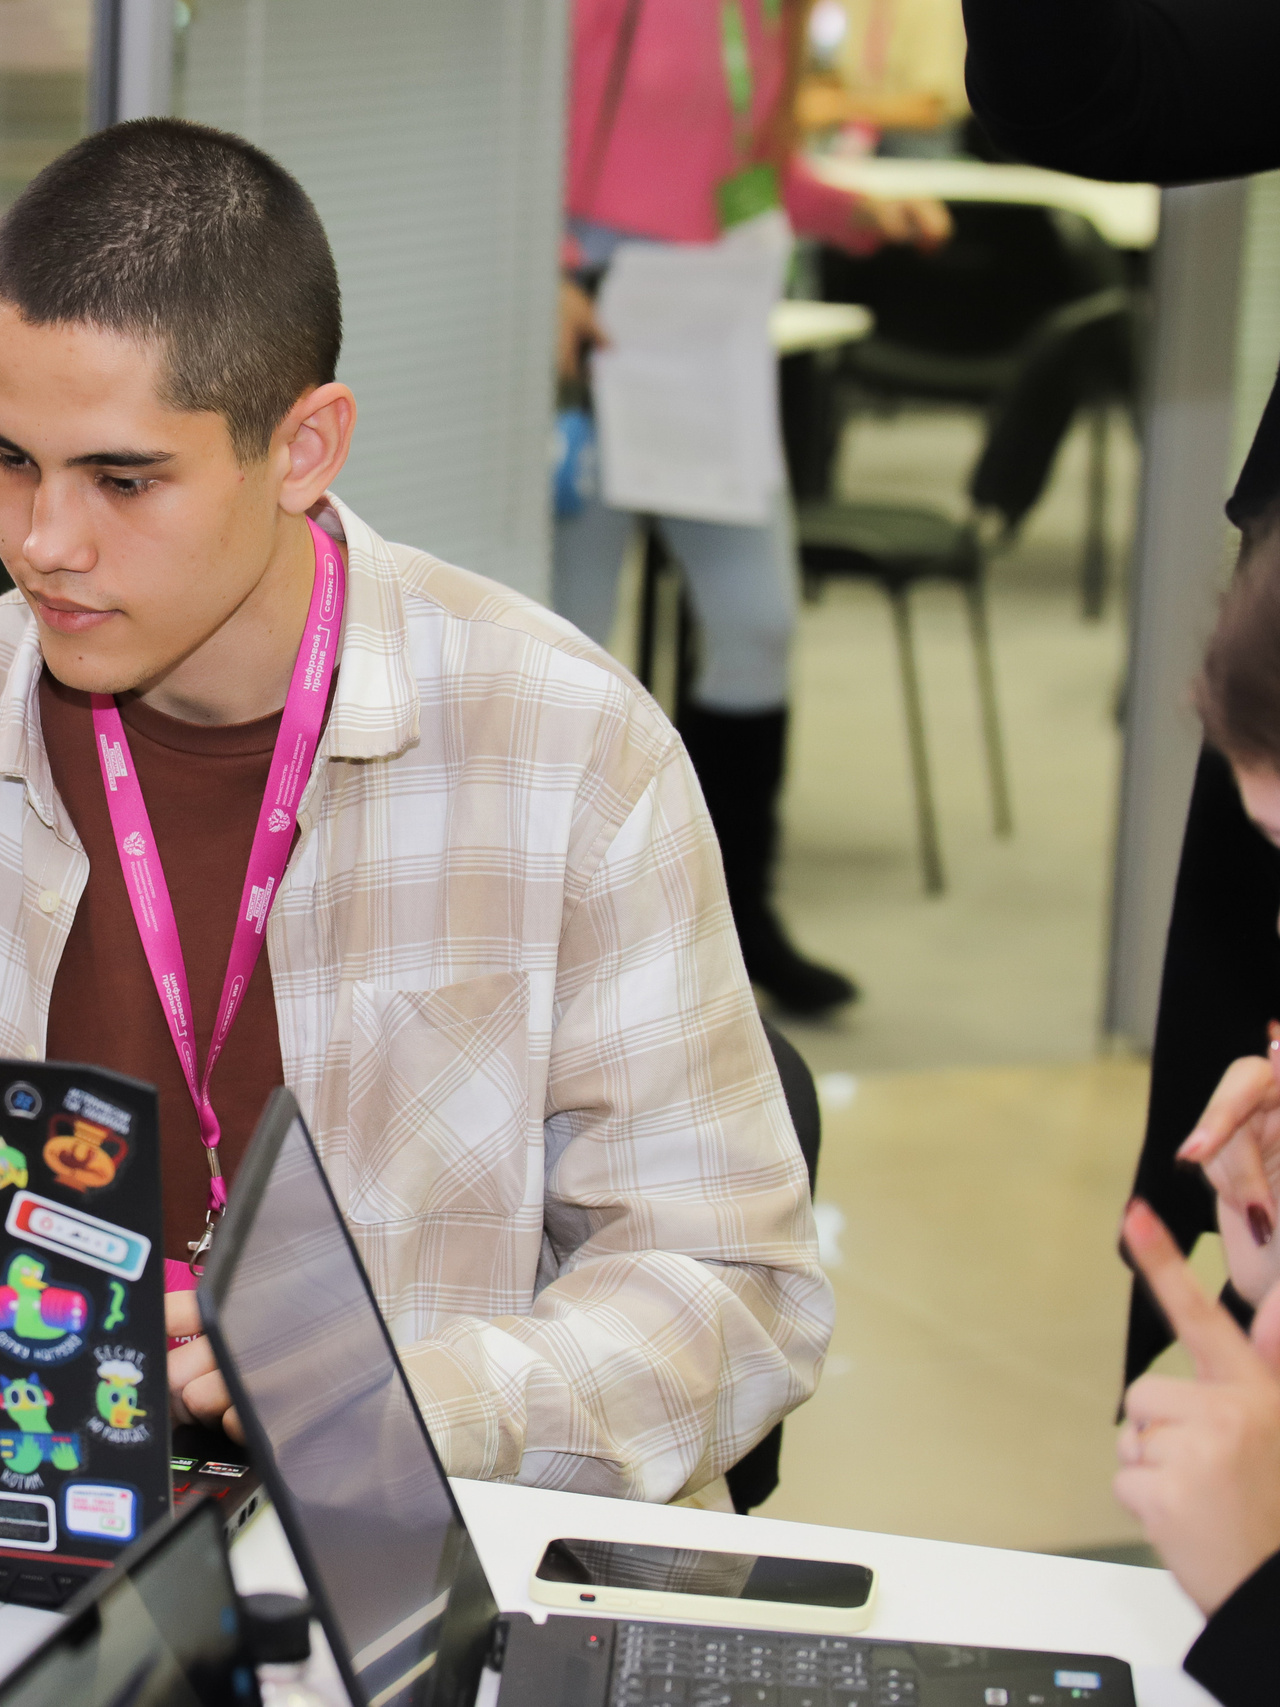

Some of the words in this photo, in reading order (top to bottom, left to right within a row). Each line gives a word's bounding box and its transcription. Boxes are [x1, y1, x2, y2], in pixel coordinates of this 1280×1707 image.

[303, 633, 320, 690] цифровой
[311, 650, 326, 691] прорыв
[293, 733, 302, 759] развития
[275, 764, 288, 804] Министерство
[162, 974, 177, 1014] прорыв
[169, 972, 187, 1027] цифровой
